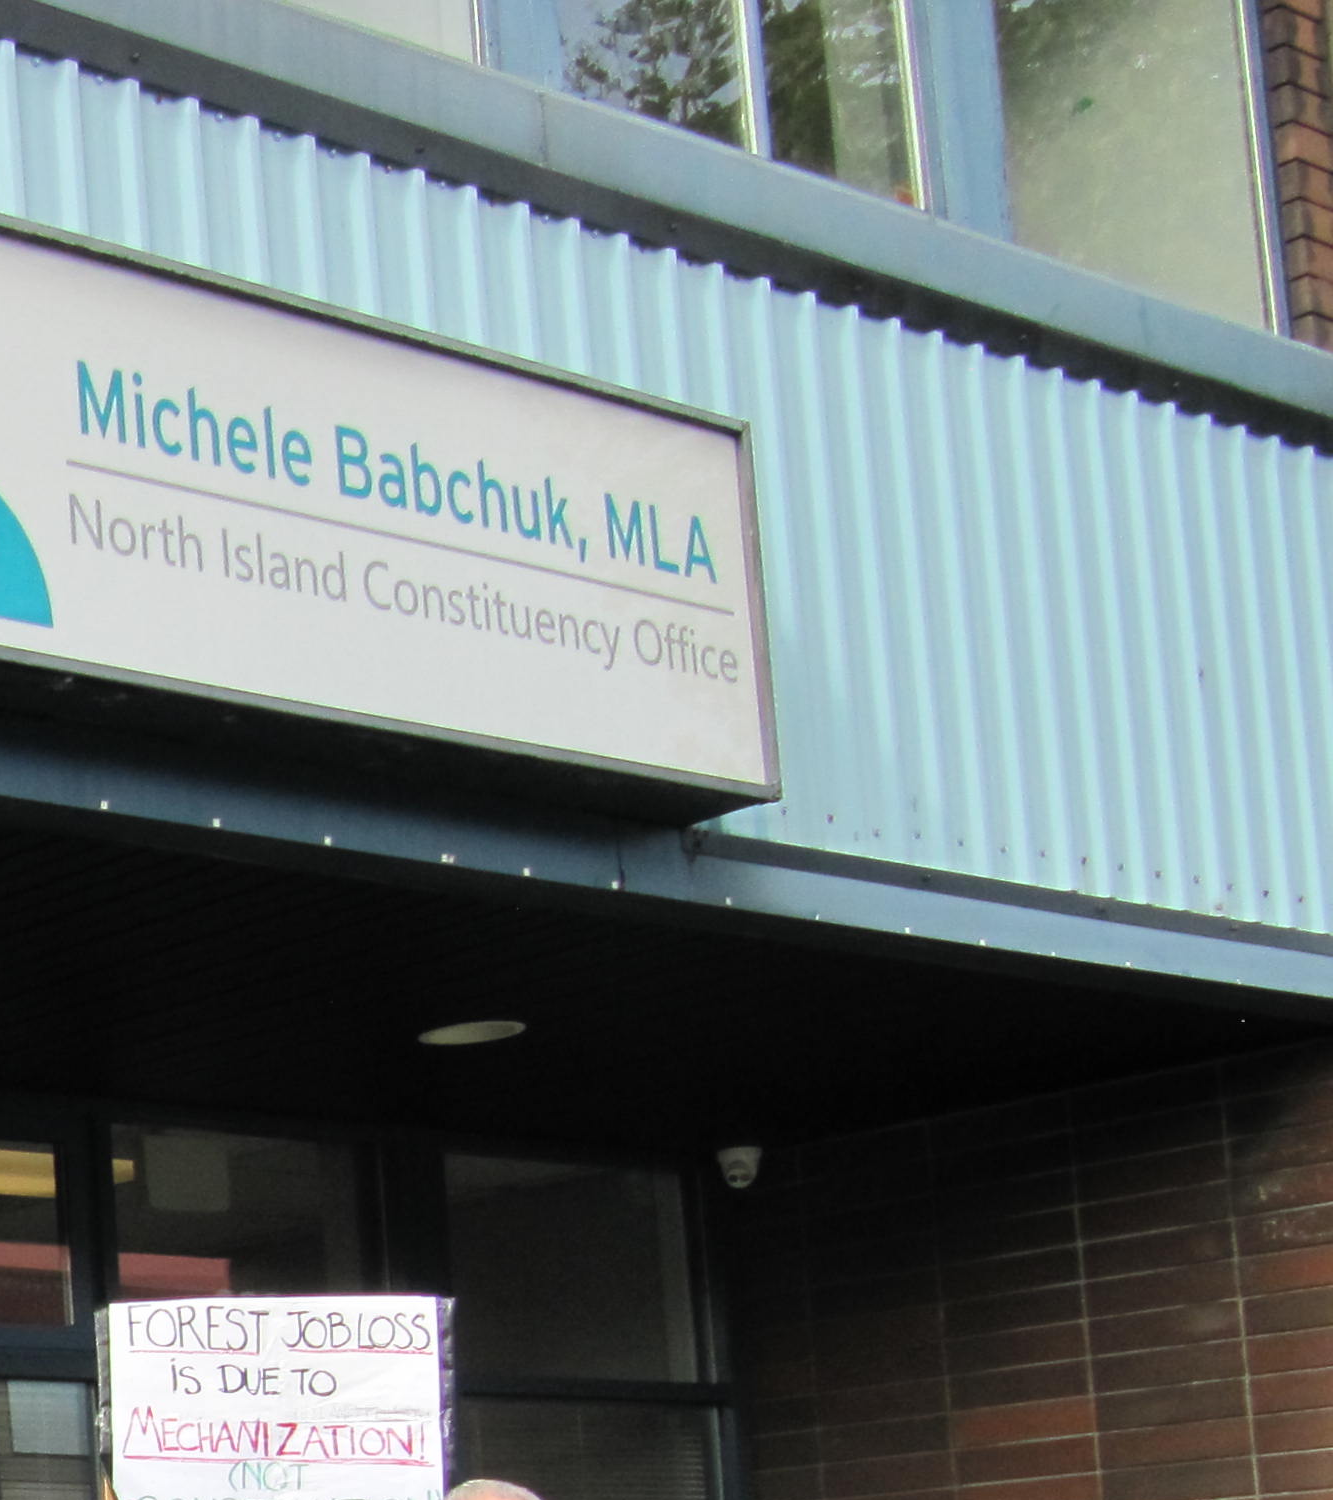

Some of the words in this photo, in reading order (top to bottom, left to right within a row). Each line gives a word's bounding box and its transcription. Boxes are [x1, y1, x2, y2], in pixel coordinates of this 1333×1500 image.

[76, 360, 313, 489] Michele
[335, 425, 589, 566] Babchuk,
[605, 493, 720, 586] MLA
[68, 492, 206, 574] North
[223, 525, 349, 605] Island
[363, 560, 623, 673] Constituency
[632, 616, 740, 687] Office
[127, 1305, 270, 1355] FOREST
[217, 1364, 281, 1397] DUE
[291, 1368, 338, 1398] TO
[122, 1405, 426, 1460] MECHANIZATION!
